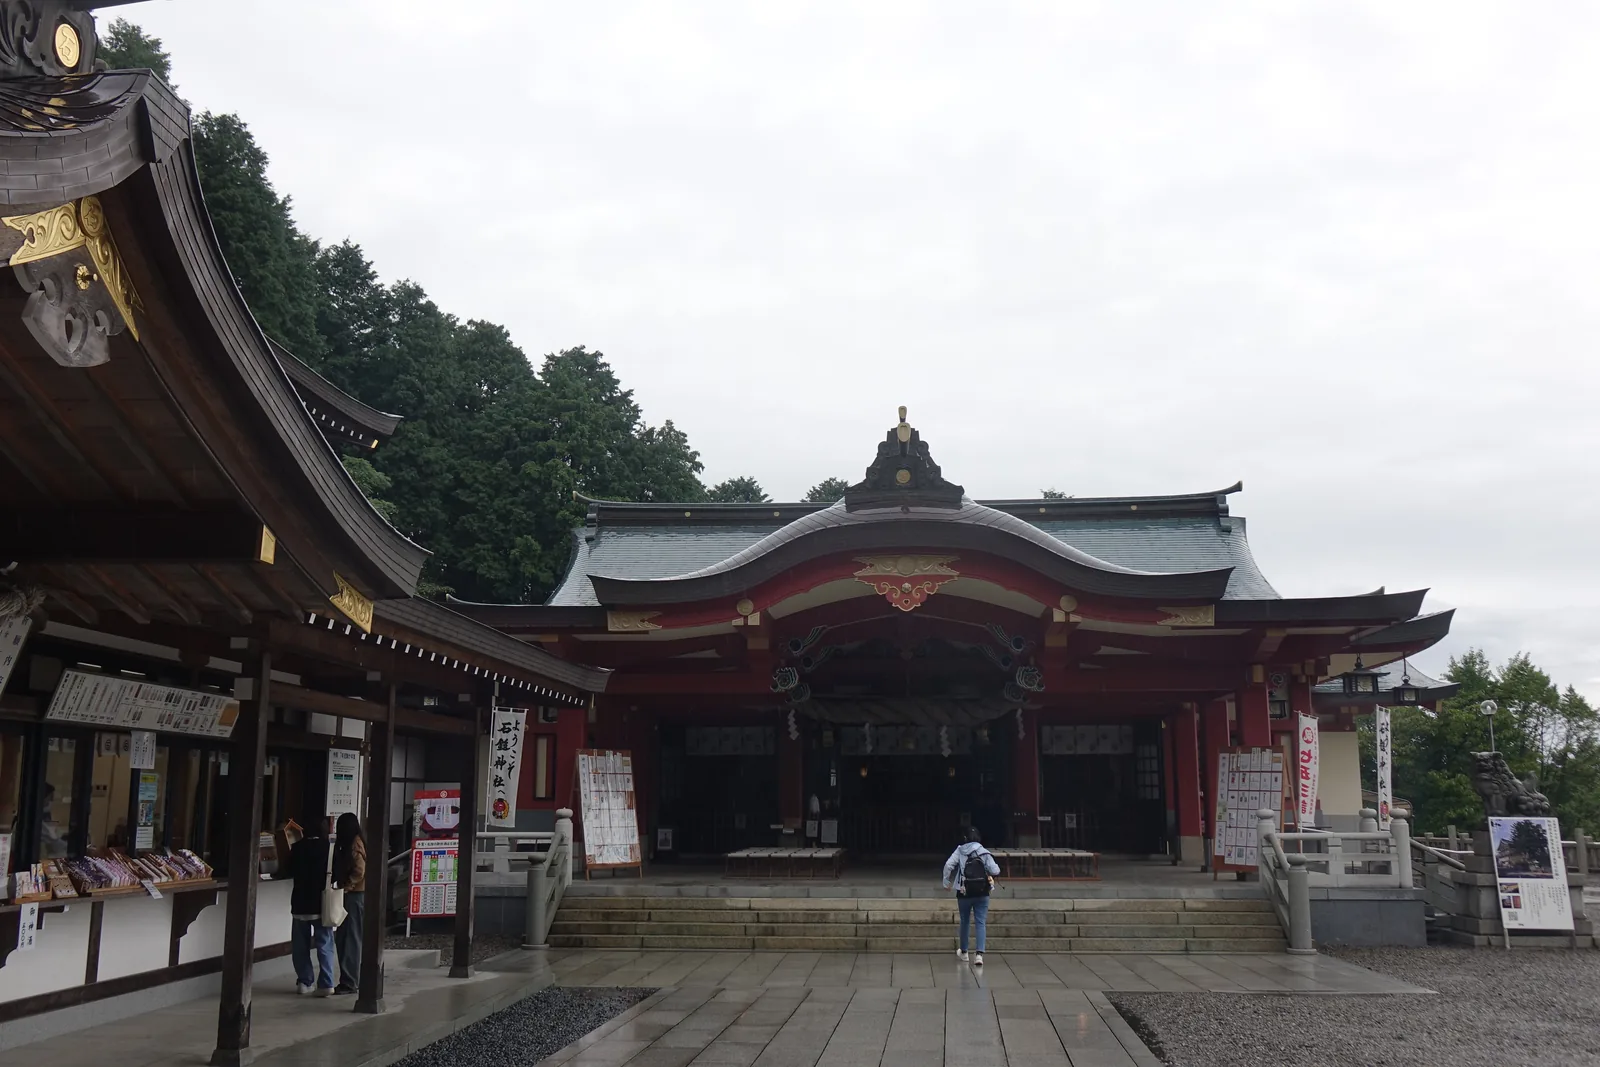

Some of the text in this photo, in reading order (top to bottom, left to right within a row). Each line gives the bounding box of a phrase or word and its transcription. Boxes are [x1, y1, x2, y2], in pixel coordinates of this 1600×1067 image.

[493, 721, 512, 795] 石鎚神社へ
[507, 719, 521, 780] ようこそ
[1300, 749, 1313, 815] 七五三詣
